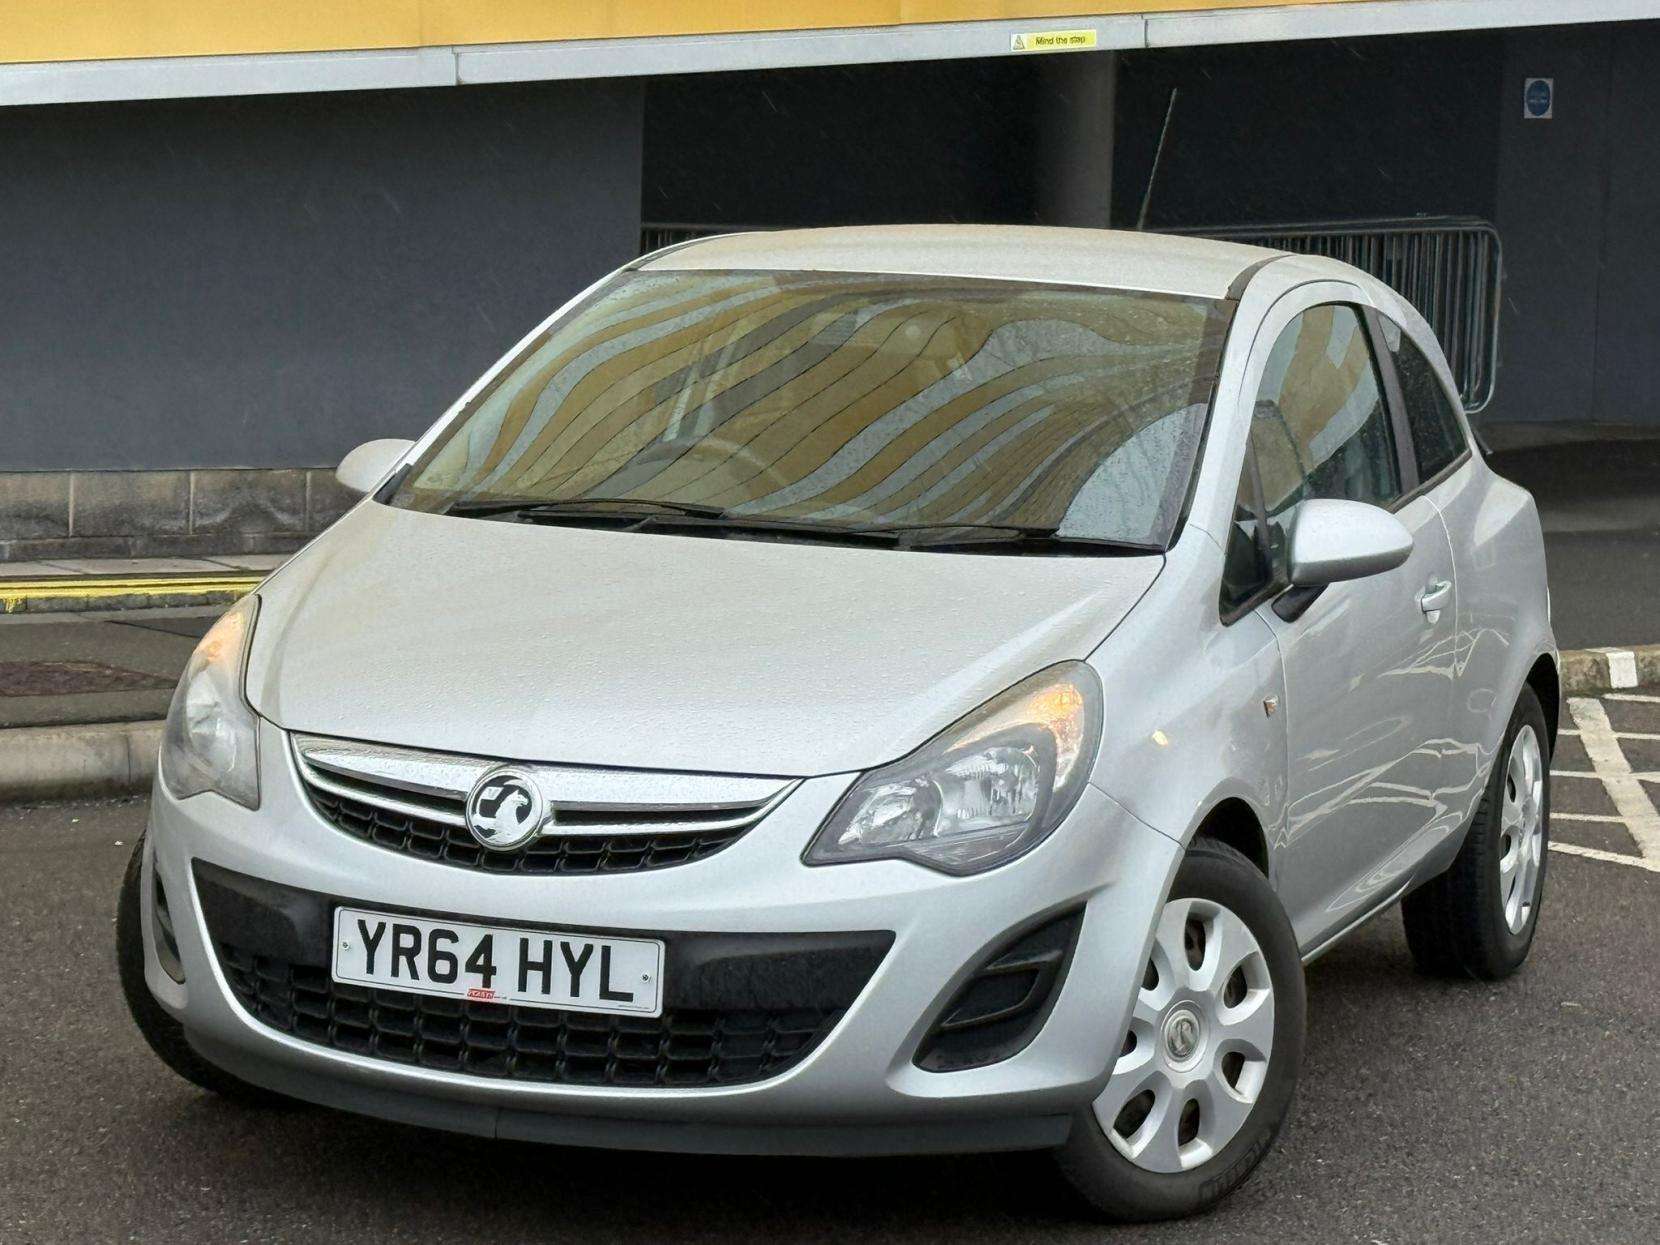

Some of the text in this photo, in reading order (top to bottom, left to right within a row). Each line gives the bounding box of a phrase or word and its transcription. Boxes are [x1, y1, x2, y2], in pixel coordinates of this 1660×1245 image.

[1035, 36, 1086, 45] Mind the step
[357, 919, 634, 1002] YR64 HYL
